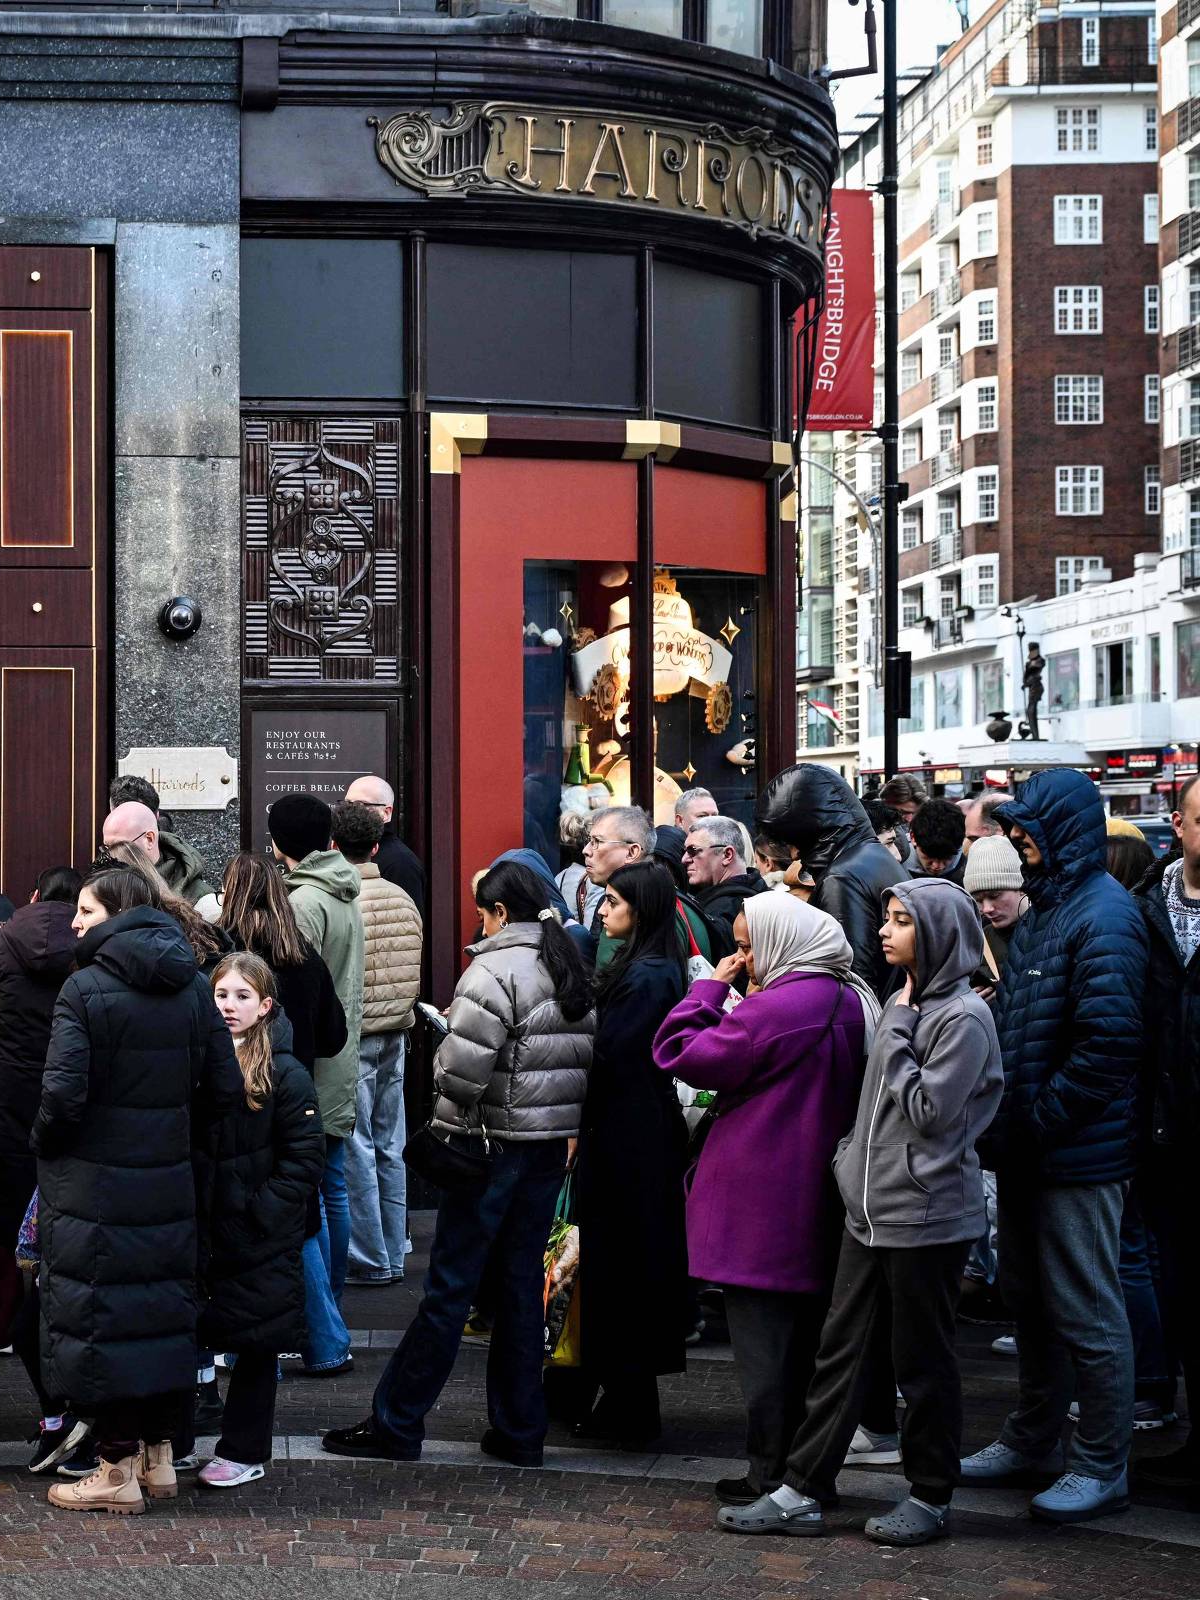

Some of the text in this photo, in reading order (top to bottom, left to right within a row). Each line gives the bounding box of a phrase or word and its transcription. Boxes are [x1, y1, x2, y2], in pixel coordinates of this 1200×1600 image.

[505, 115, 813, 243] HARRODS
[816, 212, 844, 392] KNIGHTSBRIDGE
[265, 731, 326, 740] ENJOY OUR
[265, 741, 341, 750] RESTAURANTS
[265, 750, 310, 760] & CAFÉS
[150, 767, 206, 792] Harrods
[265, 784, 345, 792] COFFEE BREAK
